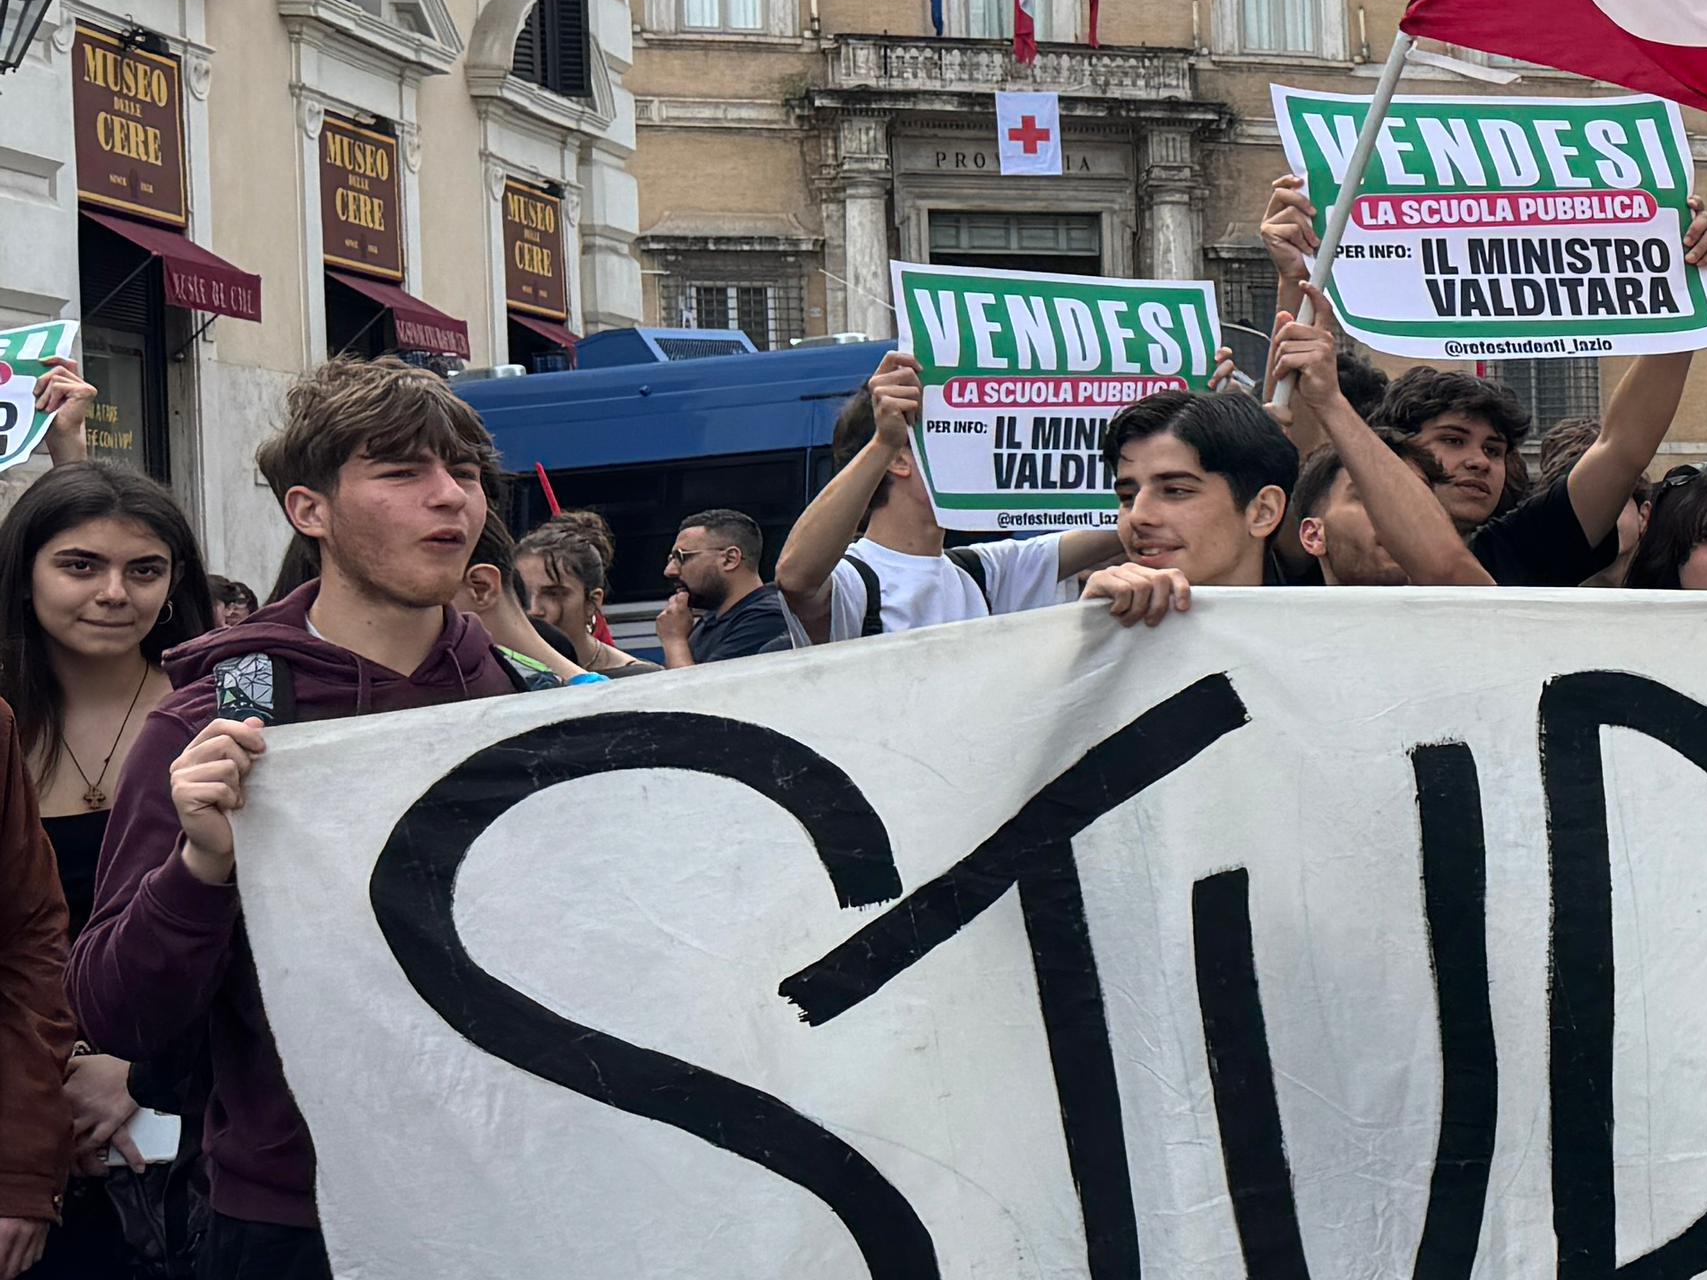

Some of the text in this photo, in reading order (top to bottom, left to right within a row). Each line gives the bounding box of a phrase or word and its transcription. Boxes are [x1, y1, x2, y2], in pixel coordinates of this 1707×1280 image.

[82, 43, 169, 108] MUSEO
[96, 111, 163, 167] CERE
[325, 130, 390, 182] MUSEO
[1301, 112, 1677, 191] VENDESI
[335, 187, 385, 232] CERE
[507, 192, 555, 234] MUSEO
[1360, 194, 1651, 226] LA SCUOLA PUBBLICA
[514, 240, 553, 278] CERE
[1334, 237, 1672, 276] PER INFO: IL MINISTRO
[1424, 276, 1680, 318] VALDITARA
[913, 288, 1207, 376] VENDESI
[951, 381, 980, 404] LA
[983, 381, 1076, 404] SCUOLA
[926, 420, 951, 434] PER
[952, 420, 989, 435] INFO:
[994, 415, 1022, 450] IL
[992, 452, 1116, 490] VALDIT
[997, 511, 1118, 529] @retestudenti_laz
